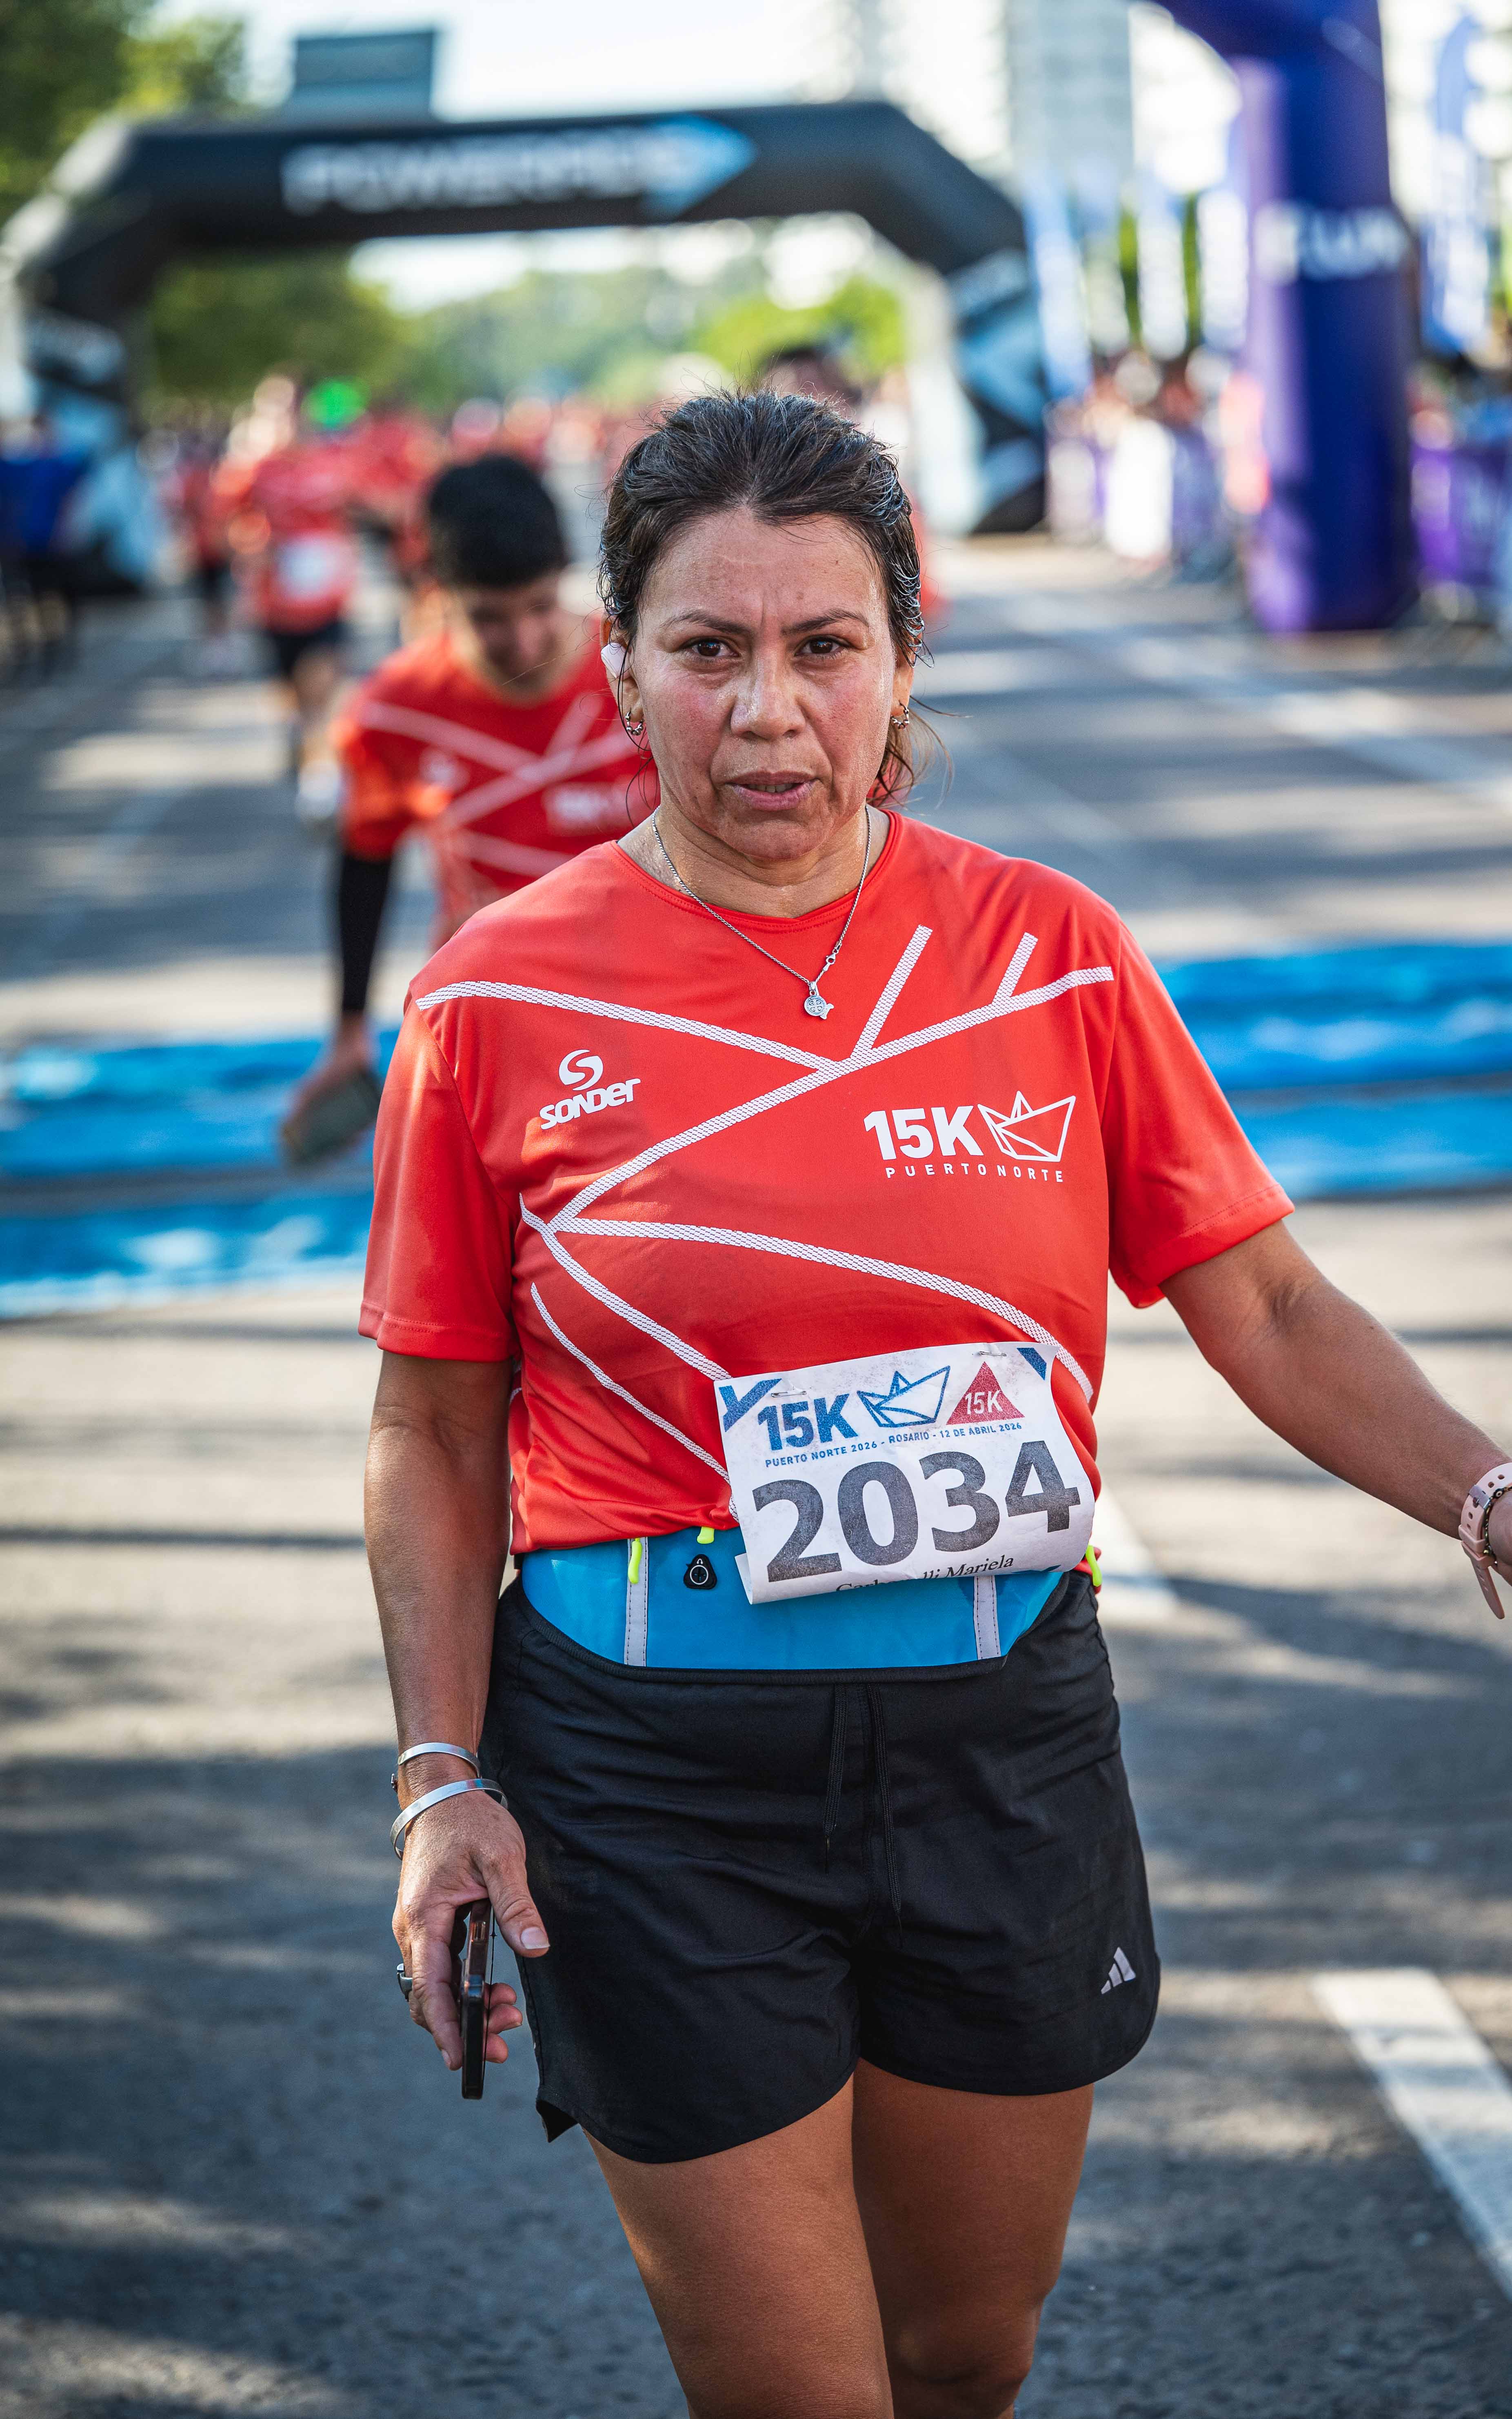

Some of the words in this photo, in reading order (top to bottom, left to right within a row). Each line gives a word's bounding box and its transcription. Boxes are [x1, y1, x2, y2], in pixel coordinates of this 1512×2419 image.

[863, 1105, 984, 1160] 15K
[757, 1393, 859, 1451] 15K
[965, 1389, 1003, 1415] 15K
[765, 1454, 808, 1468] PUERTO
[811, 1446, 847, 1460] NORTE
[851, 1441, 877, 1452] 2026
[888, 1431, 929, 1444] ROSARIO
[940, 1430, 950, 1438] 12
[953, 1428, 966, 1437] DE
[969, 1426, 996, 1435] ABRIL
[999, 1422, 1022, 1432] 2026
[752, 1440, 1081, 1583] 2034
[946, 1554, 1014, 1578] Mariela
